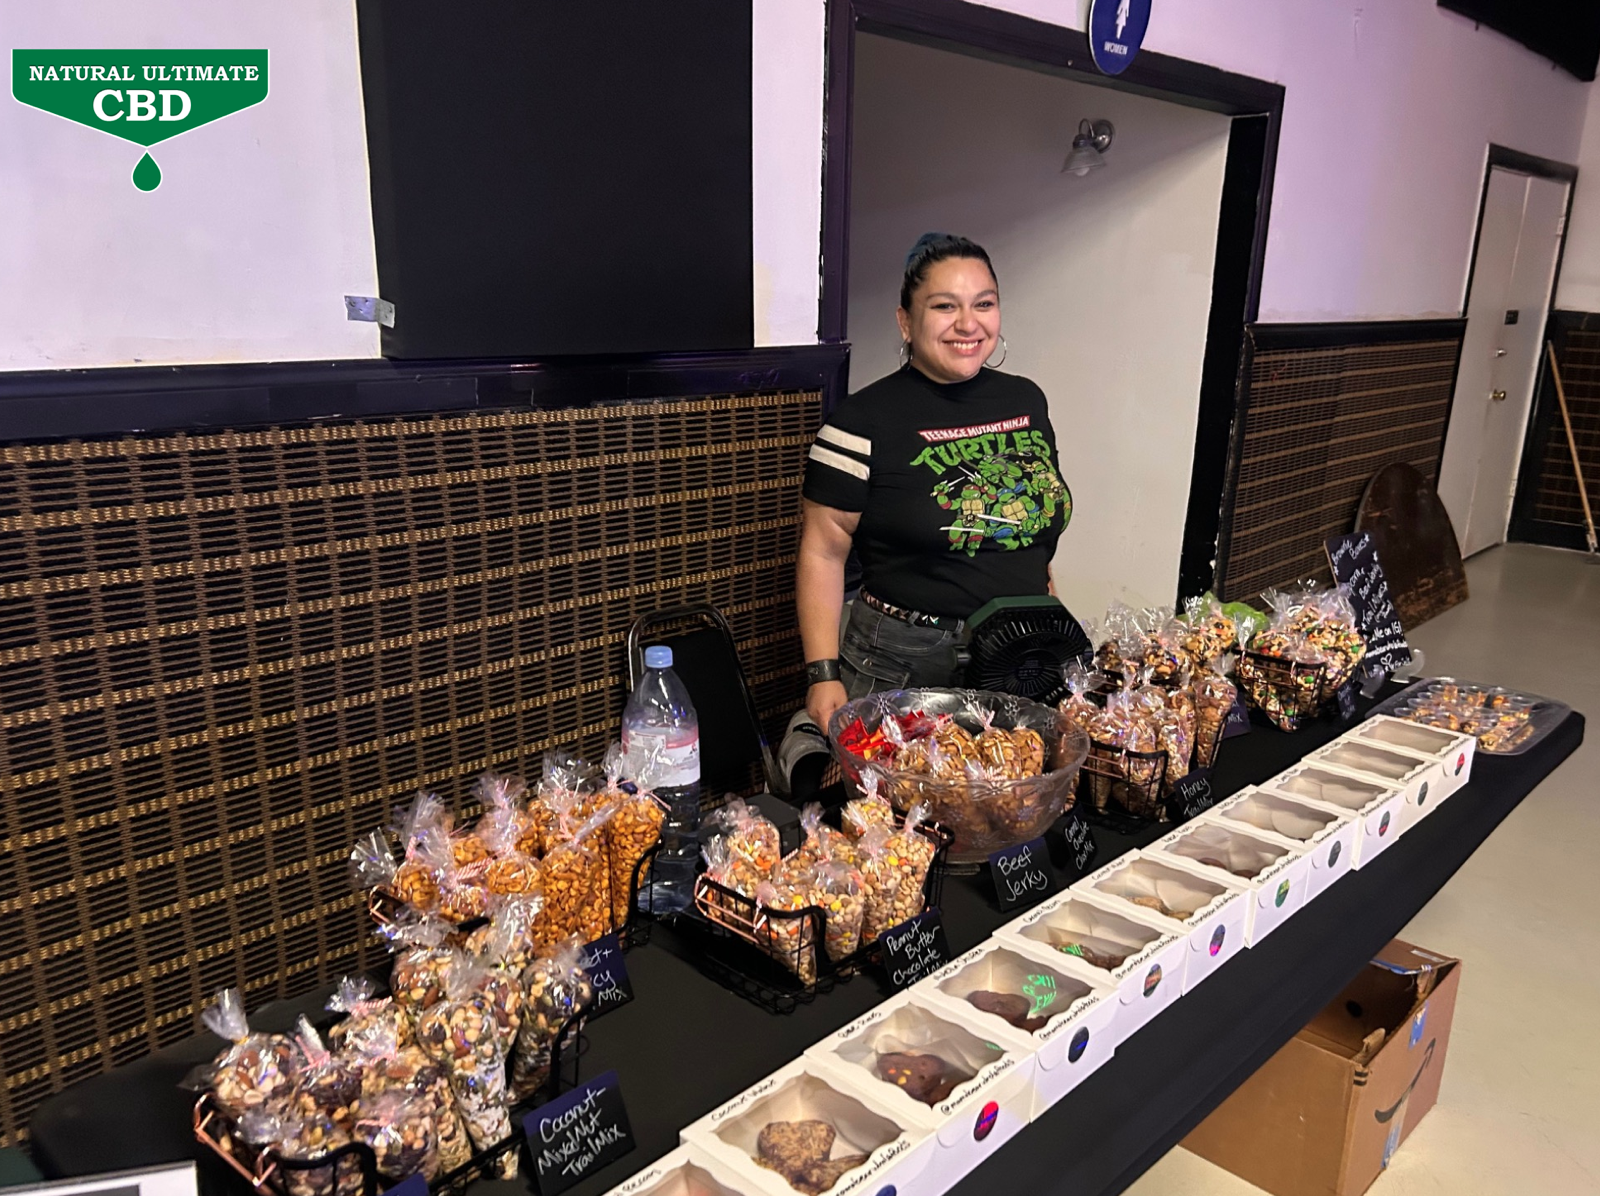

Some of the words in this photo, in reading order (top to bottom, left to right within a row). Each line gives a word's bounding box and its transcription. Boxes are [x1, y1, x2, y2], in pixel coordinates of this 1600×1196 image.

[1104, 41, 1128, 55] WOMEN
[920, 428, 969, 442] TEENAGE
[967, 422, 1002, 437] MUTANT
[1003, 416, 1029, 430] NINJA
[910, 430, 1051, 476] TURTLES
[1180, 777, 1211, 801] Honey
[997, 845, 1032, 876] Beef
[1006, 870, 1048, 901] Jerky
[886, 919, 922, 956] Peanut
[905, 926, 940, 960] Butter
[893, 948, 941, 985] Chocolate
[537, 1130, 580, 1175] Mixed
[574, 1108, 602, 1136] Nut
[562, 1137, 599, 1176] Trail
[595, 1124, 626, 1151] Mix
